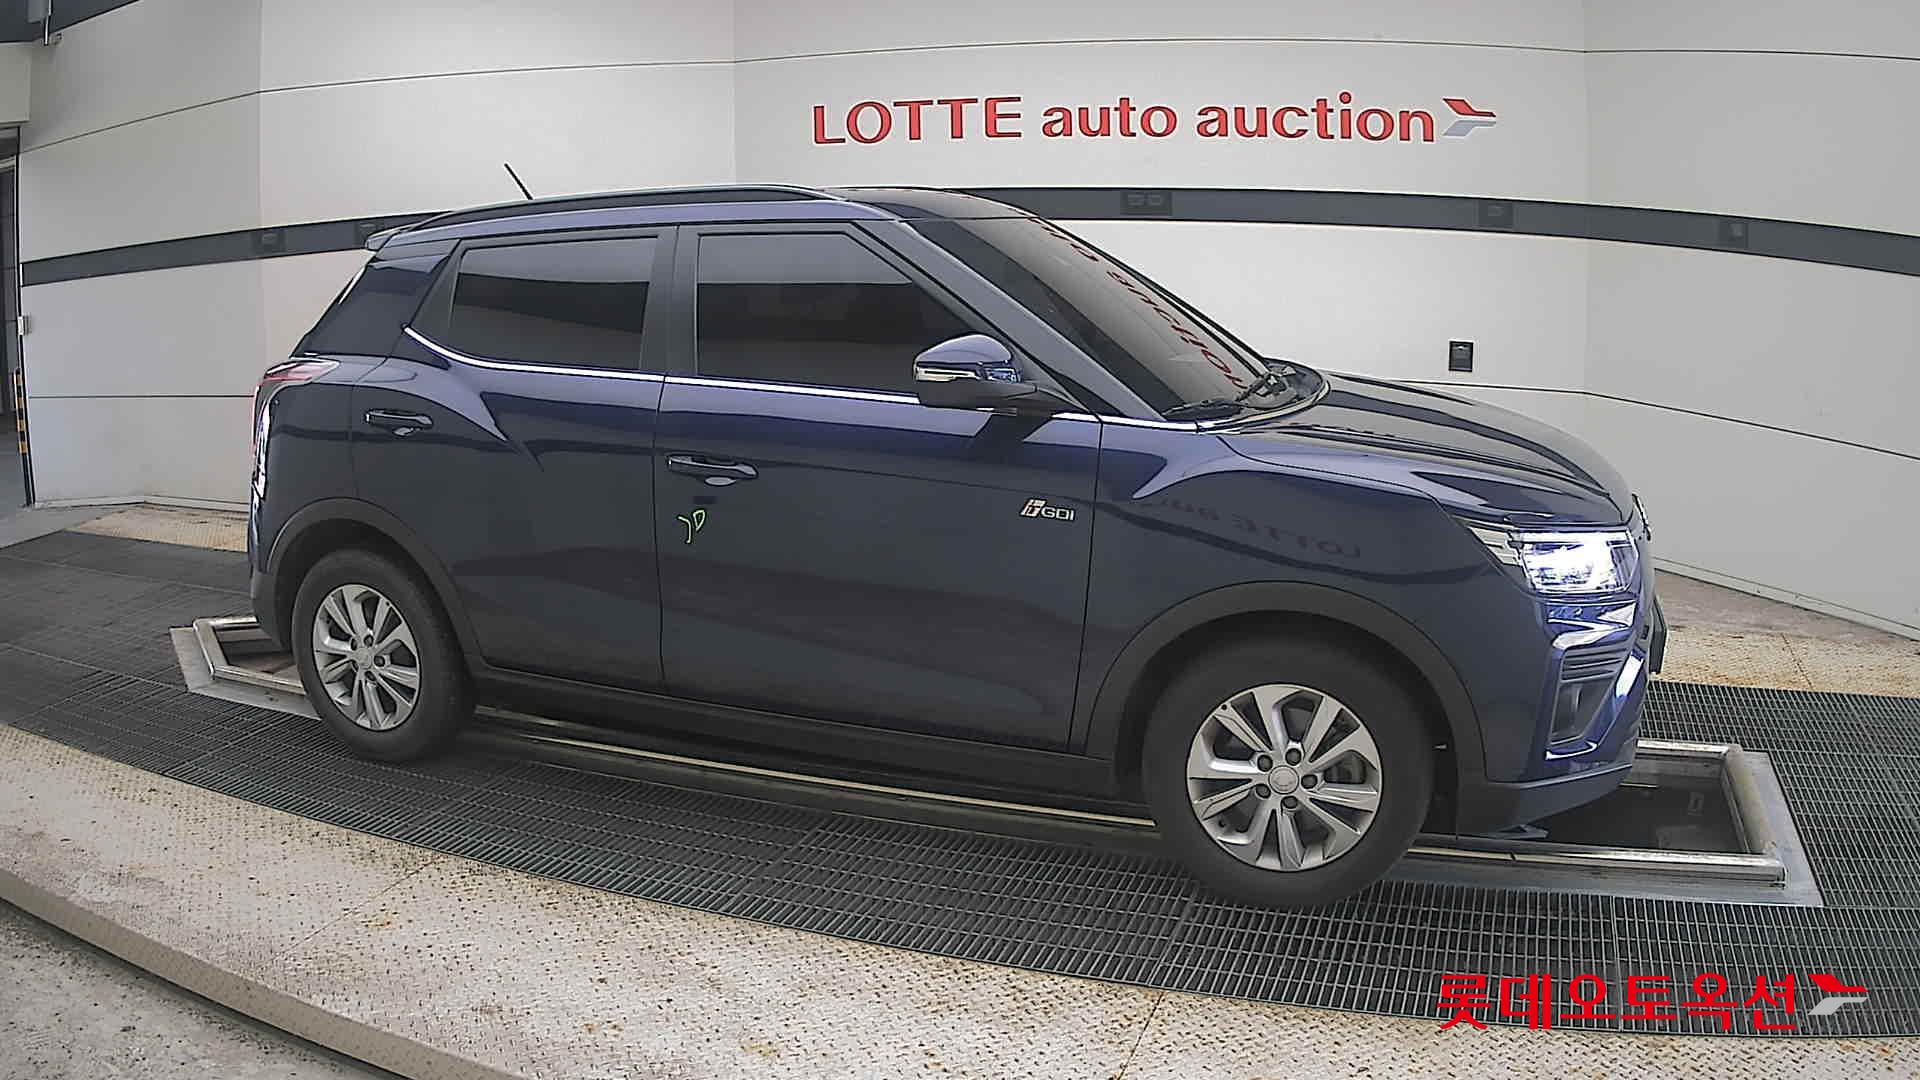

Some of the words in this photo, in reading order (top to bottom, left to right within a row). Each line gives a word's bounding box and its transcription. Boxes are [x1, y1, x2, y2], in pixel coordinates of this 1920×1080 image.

[813, 96, 1022, 144] LOTTE
[1042, 97, 1178, 138] auto
[1197, 92, 1435, 142] auction
